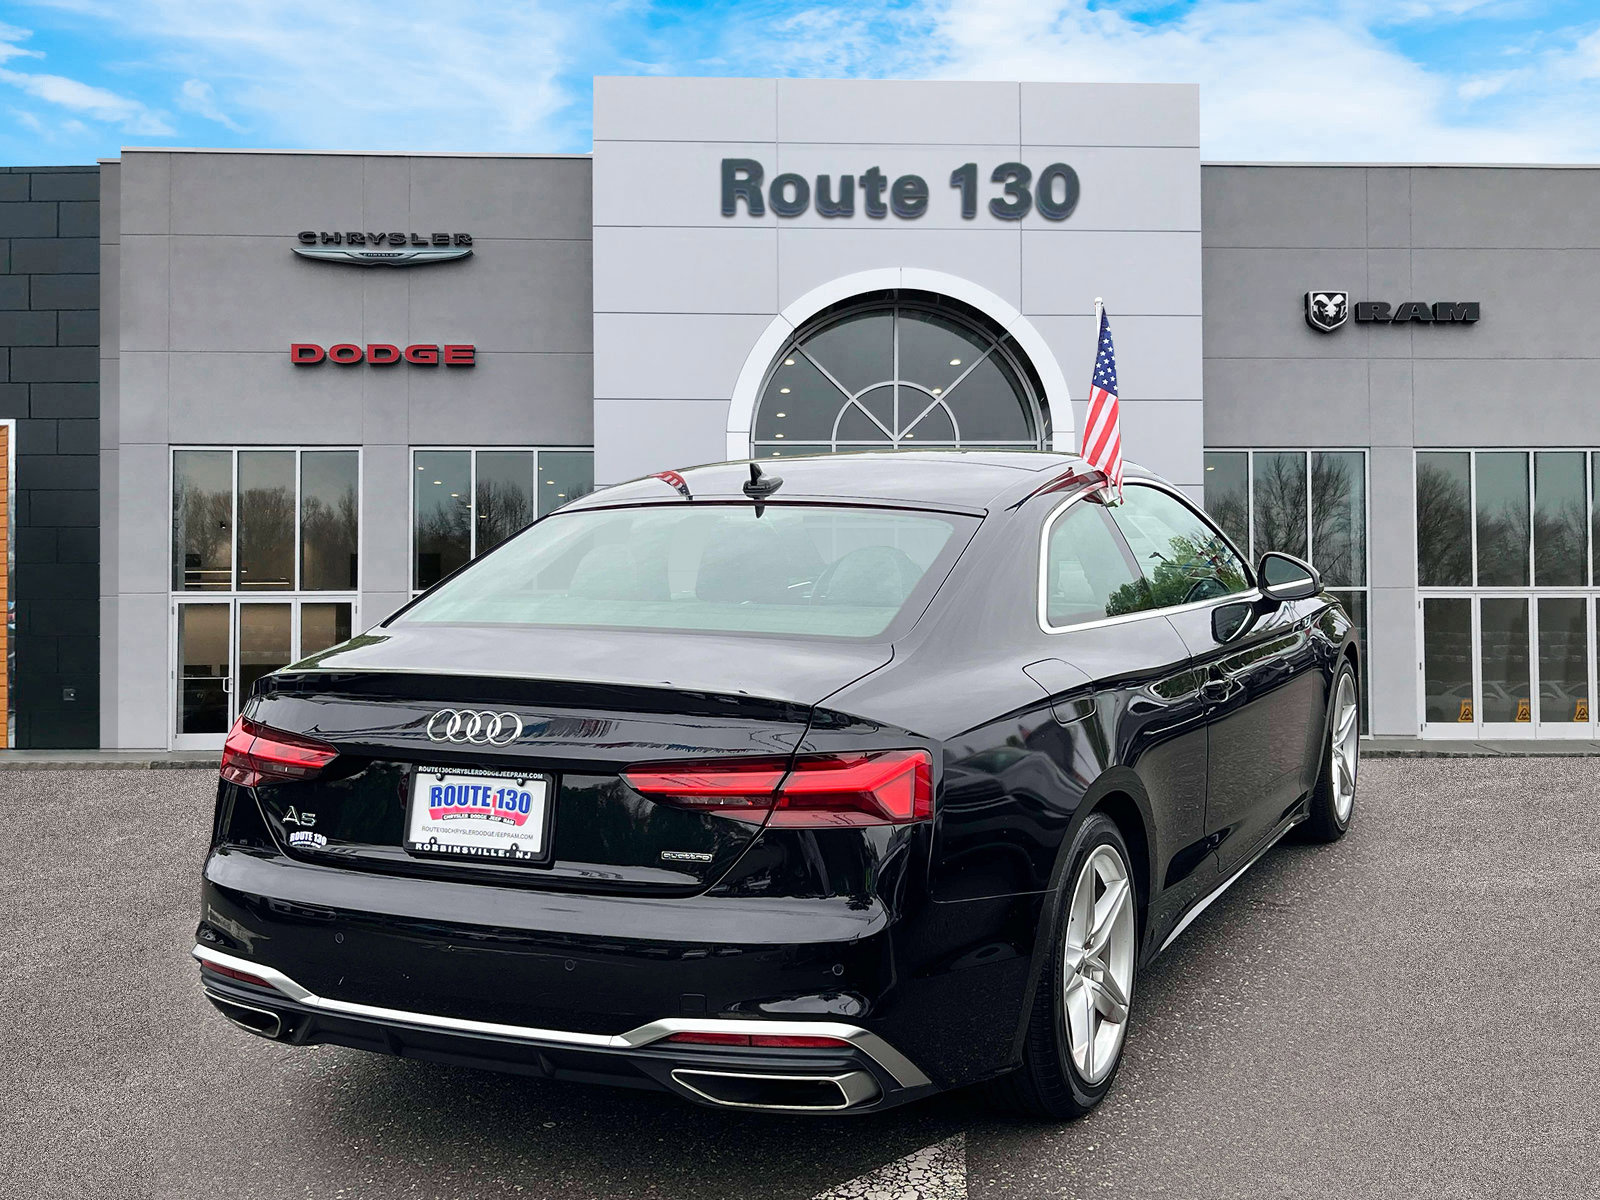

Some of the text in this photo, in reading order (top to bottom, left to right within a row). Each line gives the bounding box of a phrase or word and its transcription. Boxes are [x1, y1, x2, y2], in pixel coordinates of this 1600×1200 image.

[721, 158, 1081, 220] Route 130
[297, 230, 474, 245] CHRYSLER
[1354, 301, 1481, 324] RAM
[290, 343, 476, 366] DODGE
[418, 765, 543, 779] ROUTE130CHRYSLERDODGEJEEPRAM.COM
[430, 785, 532, 814] ROUTE 130
[281, 805, 316, 827] A5
[289, 831, 328, 846] ROUTE 130
[515, 851, 532, 859] NJ
[662, 852, 711, 861] quattro
